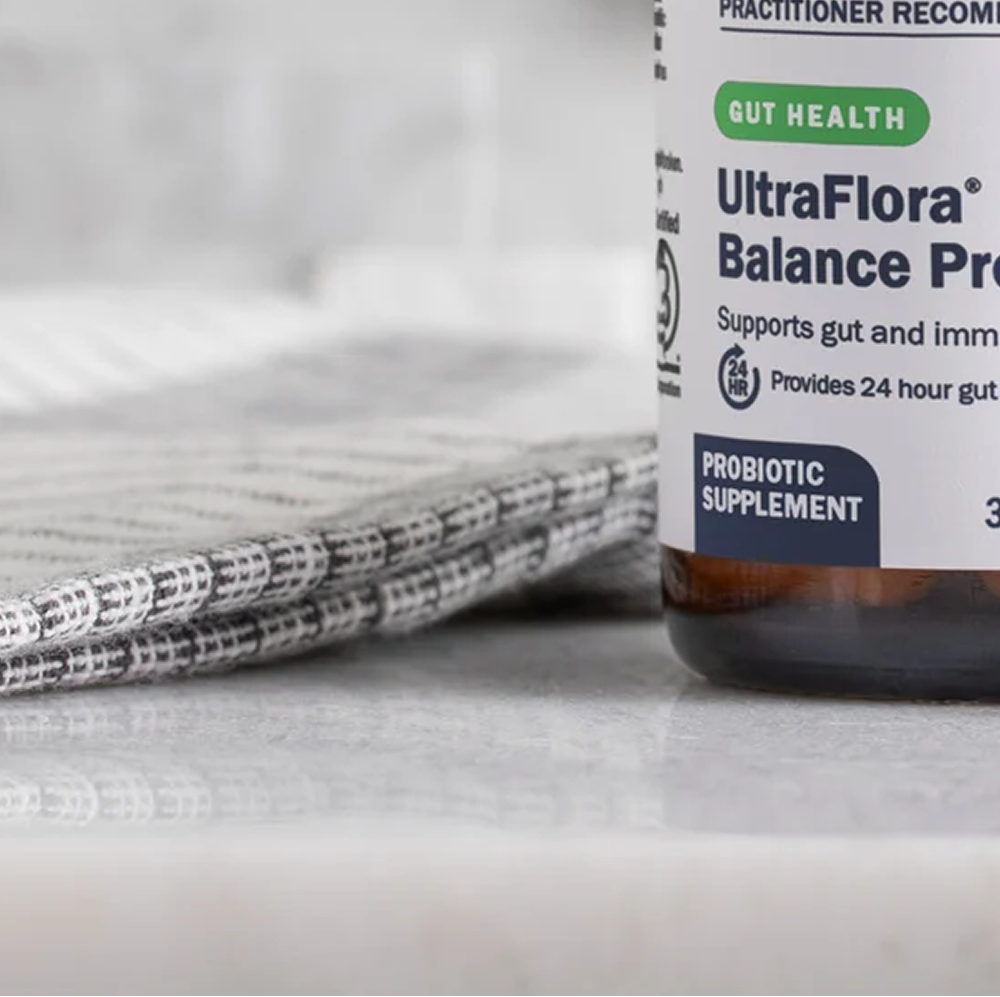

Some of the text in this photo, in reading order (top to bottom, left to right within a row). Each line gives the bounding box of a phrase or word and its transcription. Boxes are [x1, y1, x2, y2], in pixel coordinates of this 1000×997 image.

[728, 100, 905, 130] GUT HEALTH
[719, 232, 911, 288] Balance
[717, 305, 814, 341] Supports
[820, 320, 864, 348] gut
[871, 321, 924, 346] and
[728, 358, 748, 378] 24
[728, 378, 748, 397] HR
[771, 369, 856, 396] Provides
[860, 377, 892, 398] 24
[898, 378, 952, 400] hour
[958, 381, 998, 405] gut
[702, 450, 824, 486] PROBIOTIC
[702, 485, 863, 522] SUPPLEMENT
